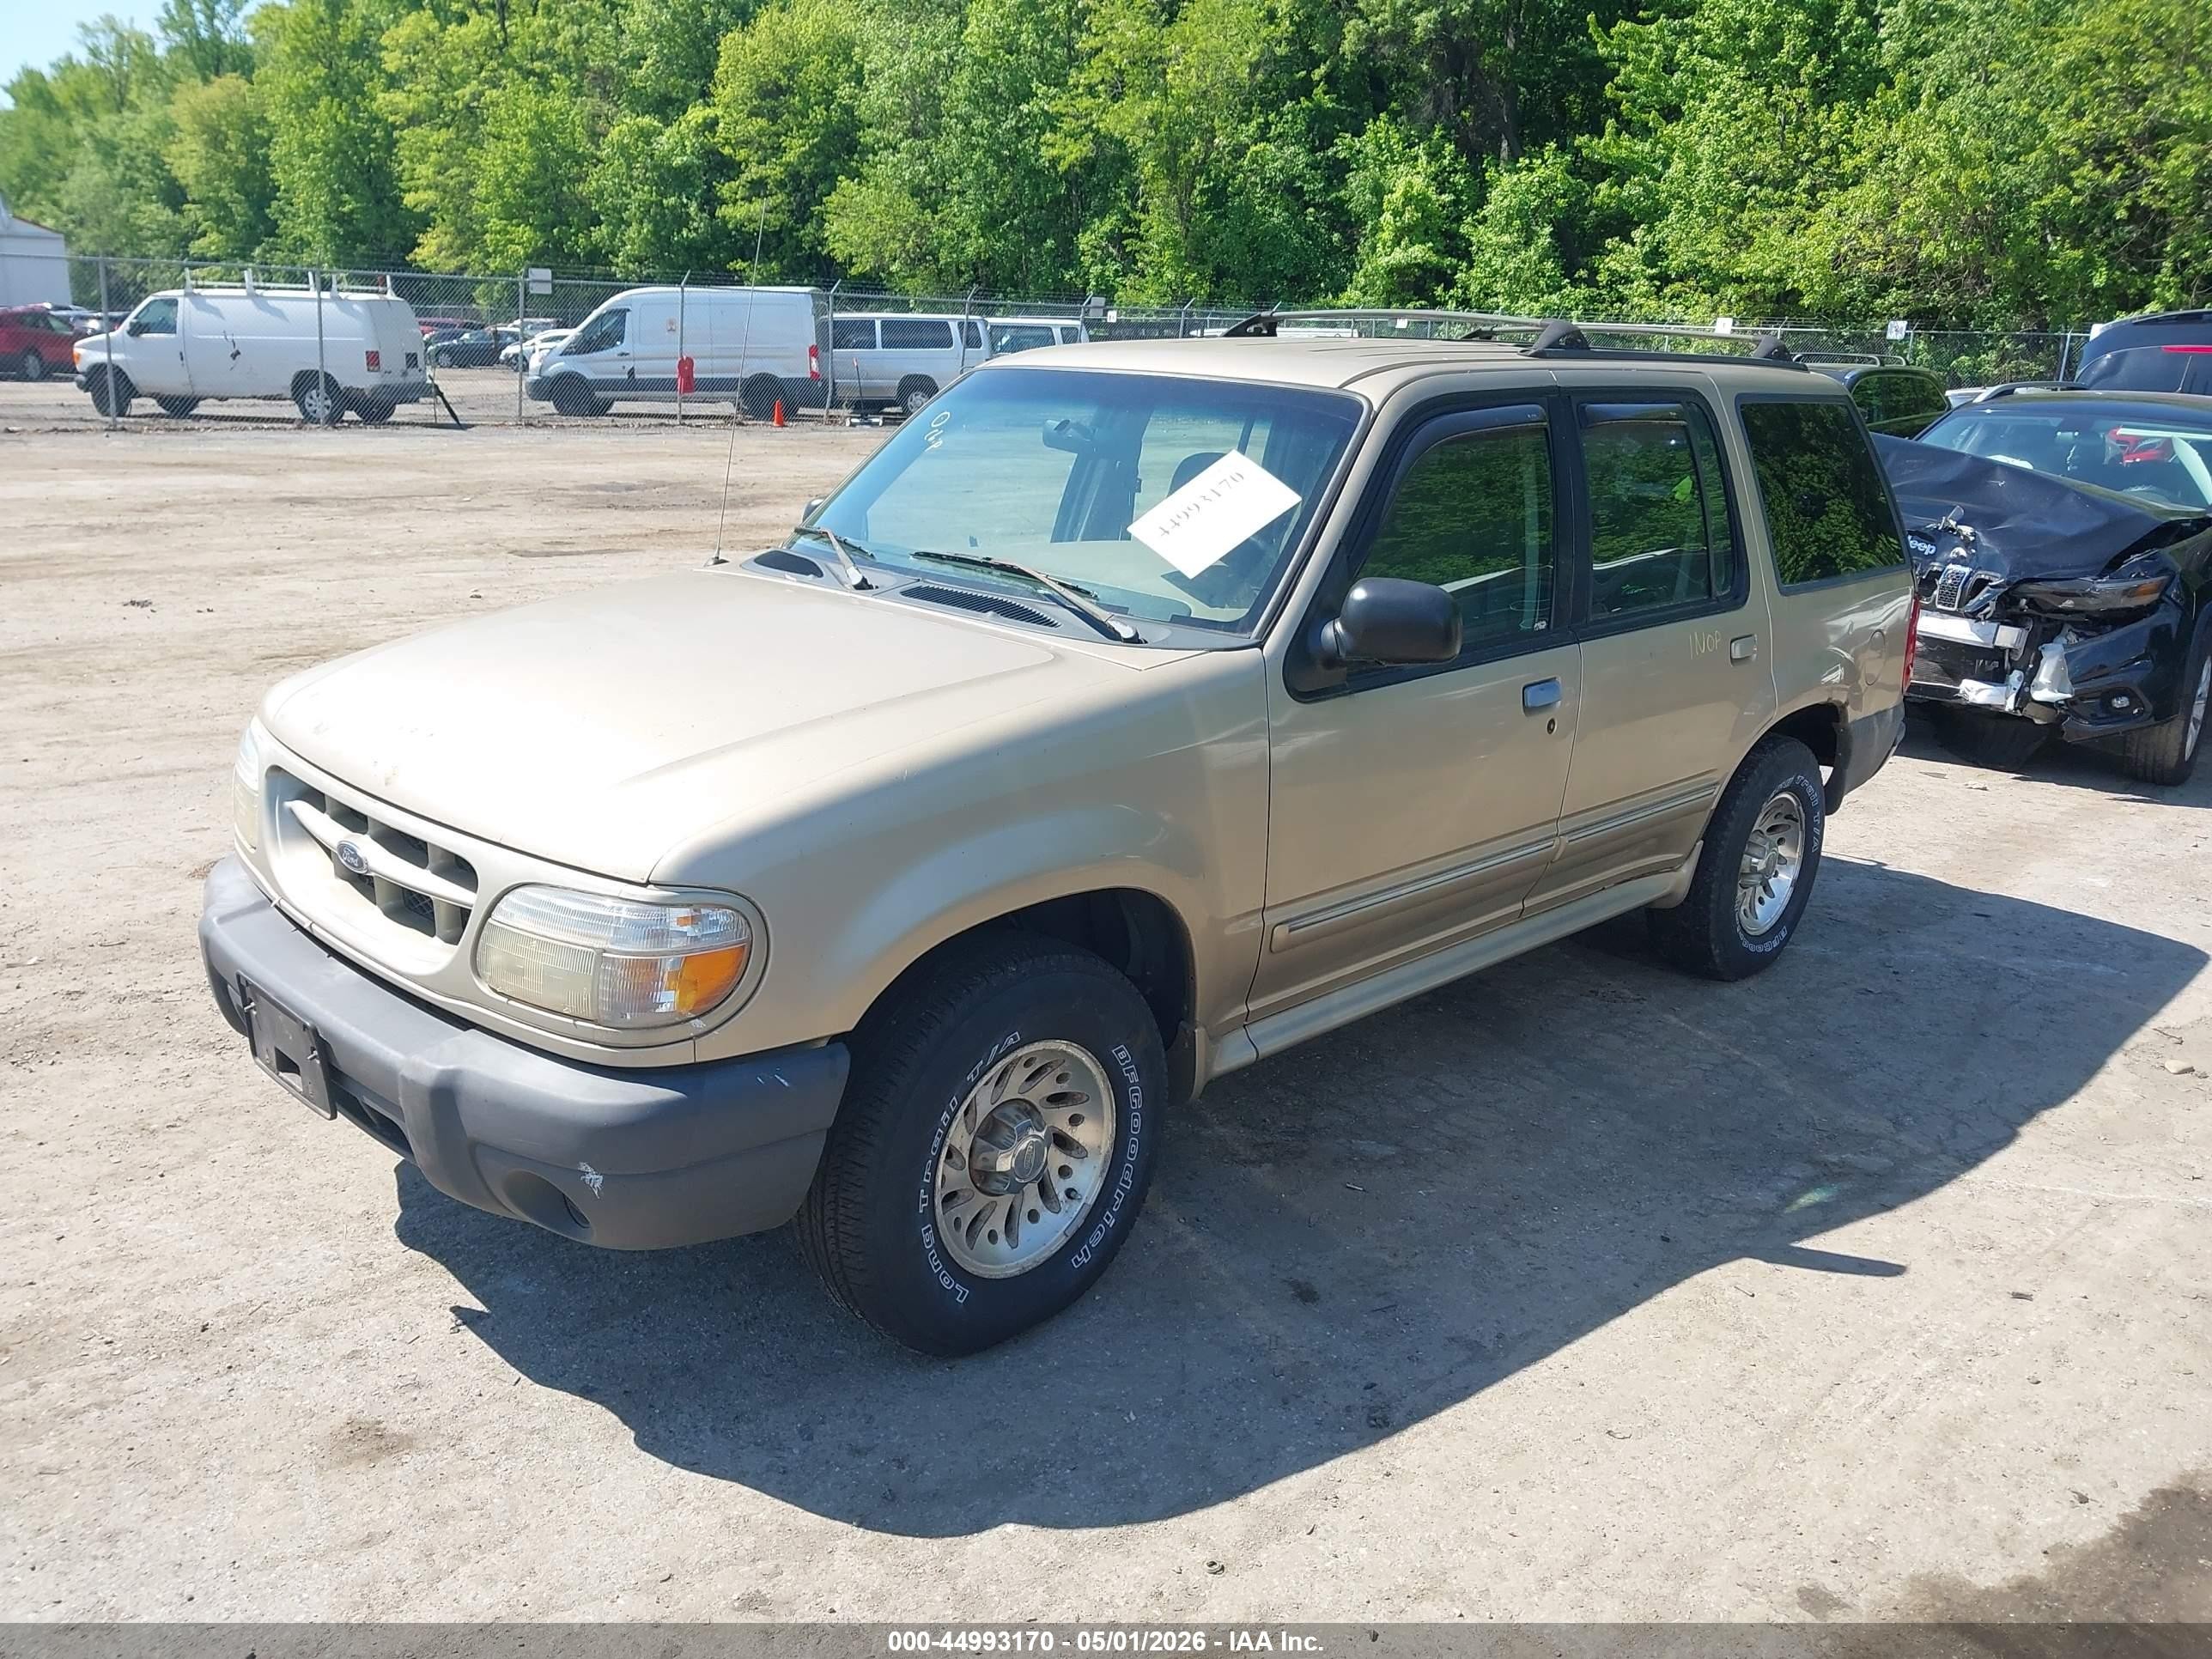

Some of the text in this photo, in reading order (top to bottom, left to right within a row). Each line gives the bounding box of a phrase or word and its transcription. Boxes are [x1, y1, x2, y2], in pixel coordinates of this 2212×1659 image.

[1158, 471, 1245, 538] 44993170
[919, 1095, 958, 1213] Trail
[1071, 1044, 1143, 1269] BFGoodrich
[921, 1224, 969, 1304] Long
